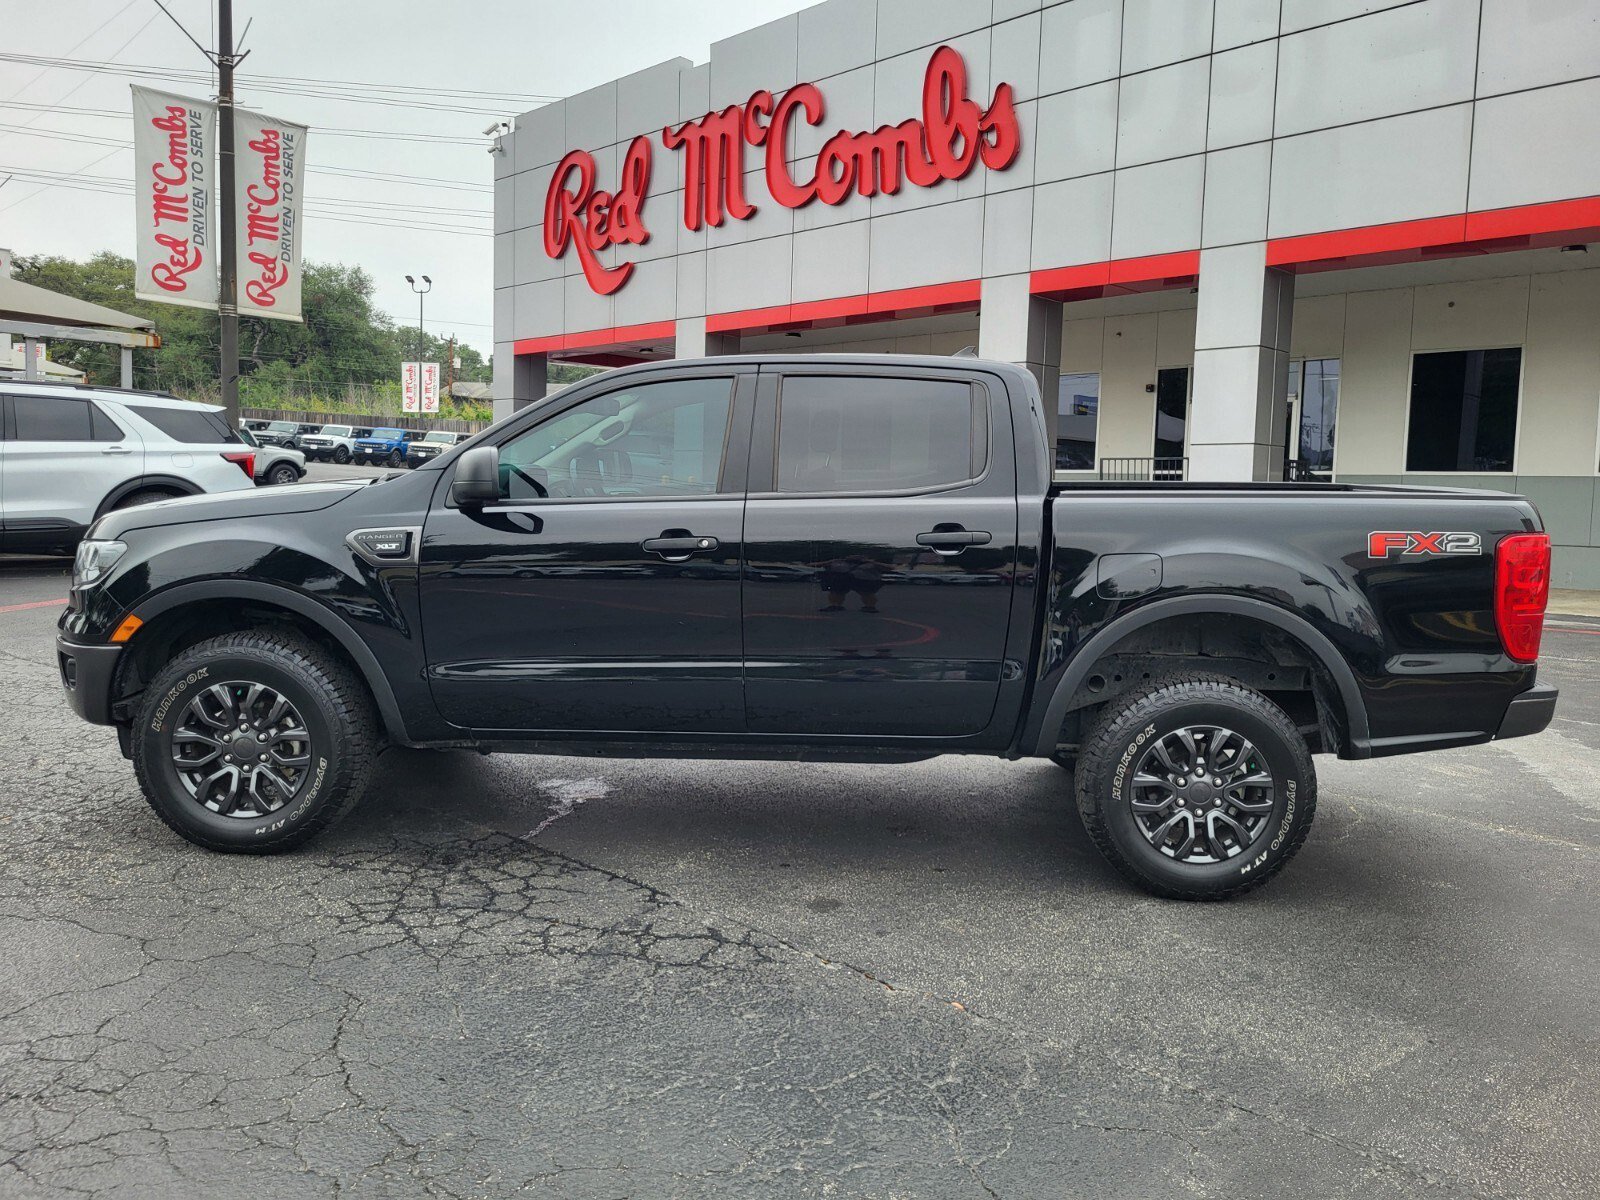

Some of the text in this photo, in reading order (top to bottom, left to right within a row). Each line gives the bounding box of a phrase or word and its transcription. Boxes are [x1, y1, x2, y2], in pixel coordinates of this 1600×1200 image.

[151, 105, 203, 292] Red McCombs
[189, 109, 205, 247] DRIVEN TO SERVE
[245, 128, 289, 307] Red McCombs
[280, 131, 294, 263] DRIVEN TO SERVE
[543, 45, 1021, 295] Red McCombs
[1367, 531, 1482, 558] FX2
